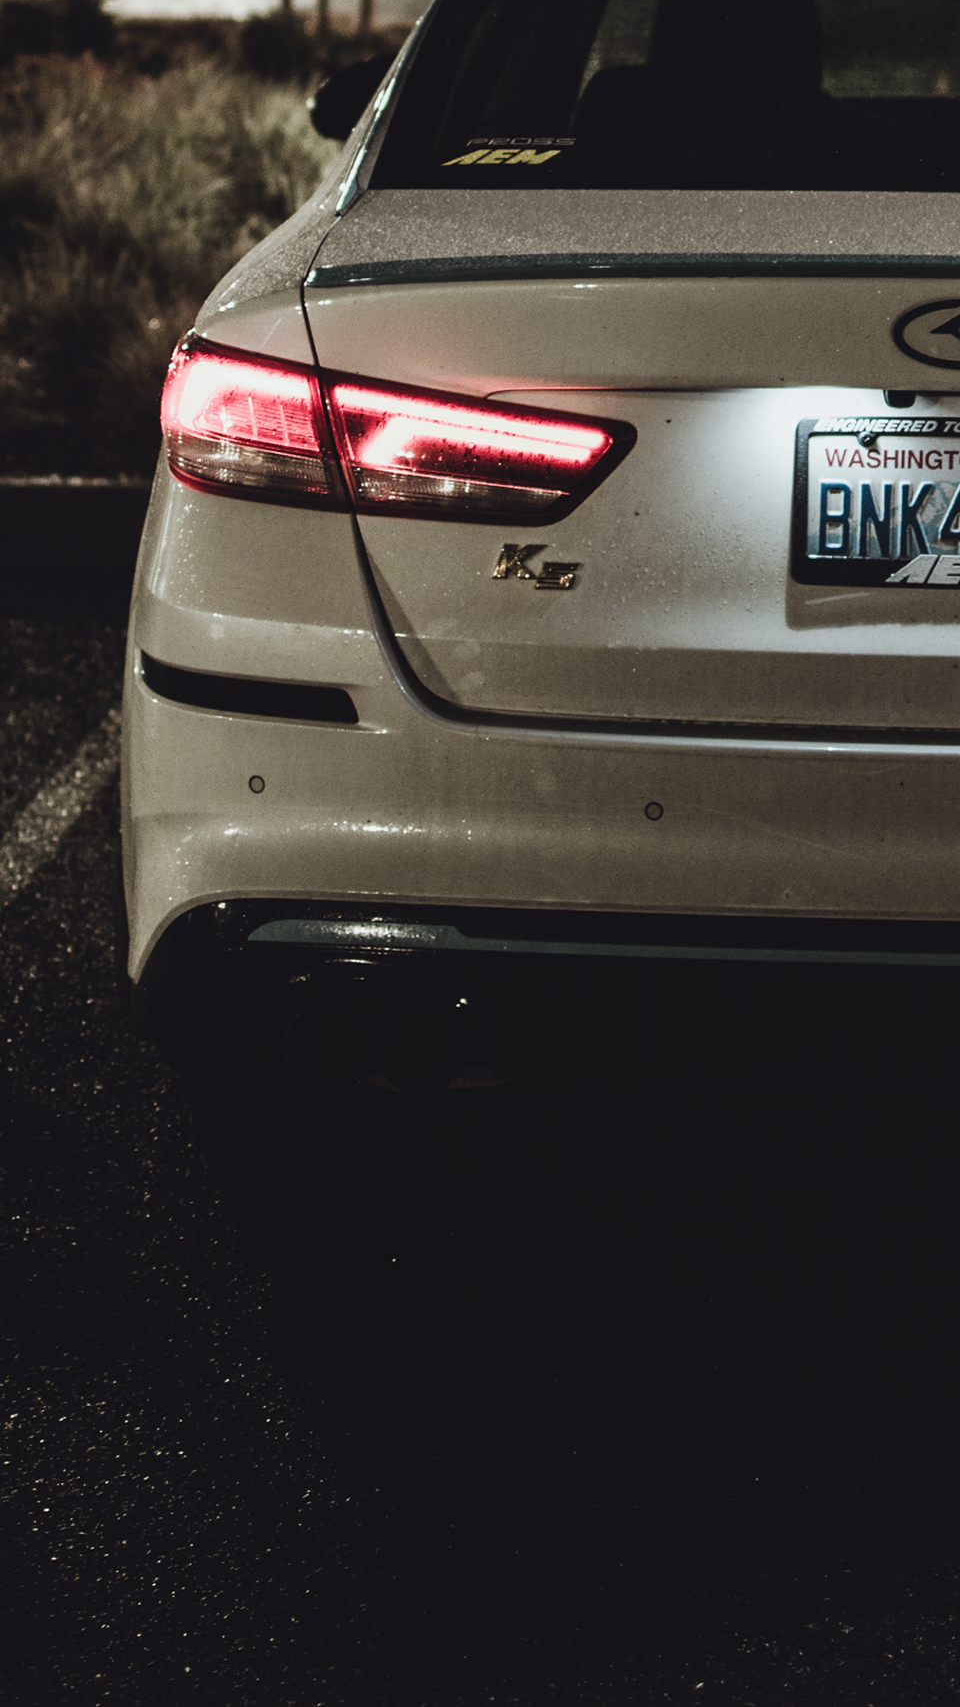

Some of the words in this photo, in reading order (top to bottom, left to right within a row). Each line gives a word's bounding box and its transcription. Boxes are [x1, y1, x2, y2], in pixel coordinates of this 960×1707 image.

[441, 149, 562, 165] AEM
[813, 418, 938, 433] ENGINEERED
[492, 543, 581, 591] K5
